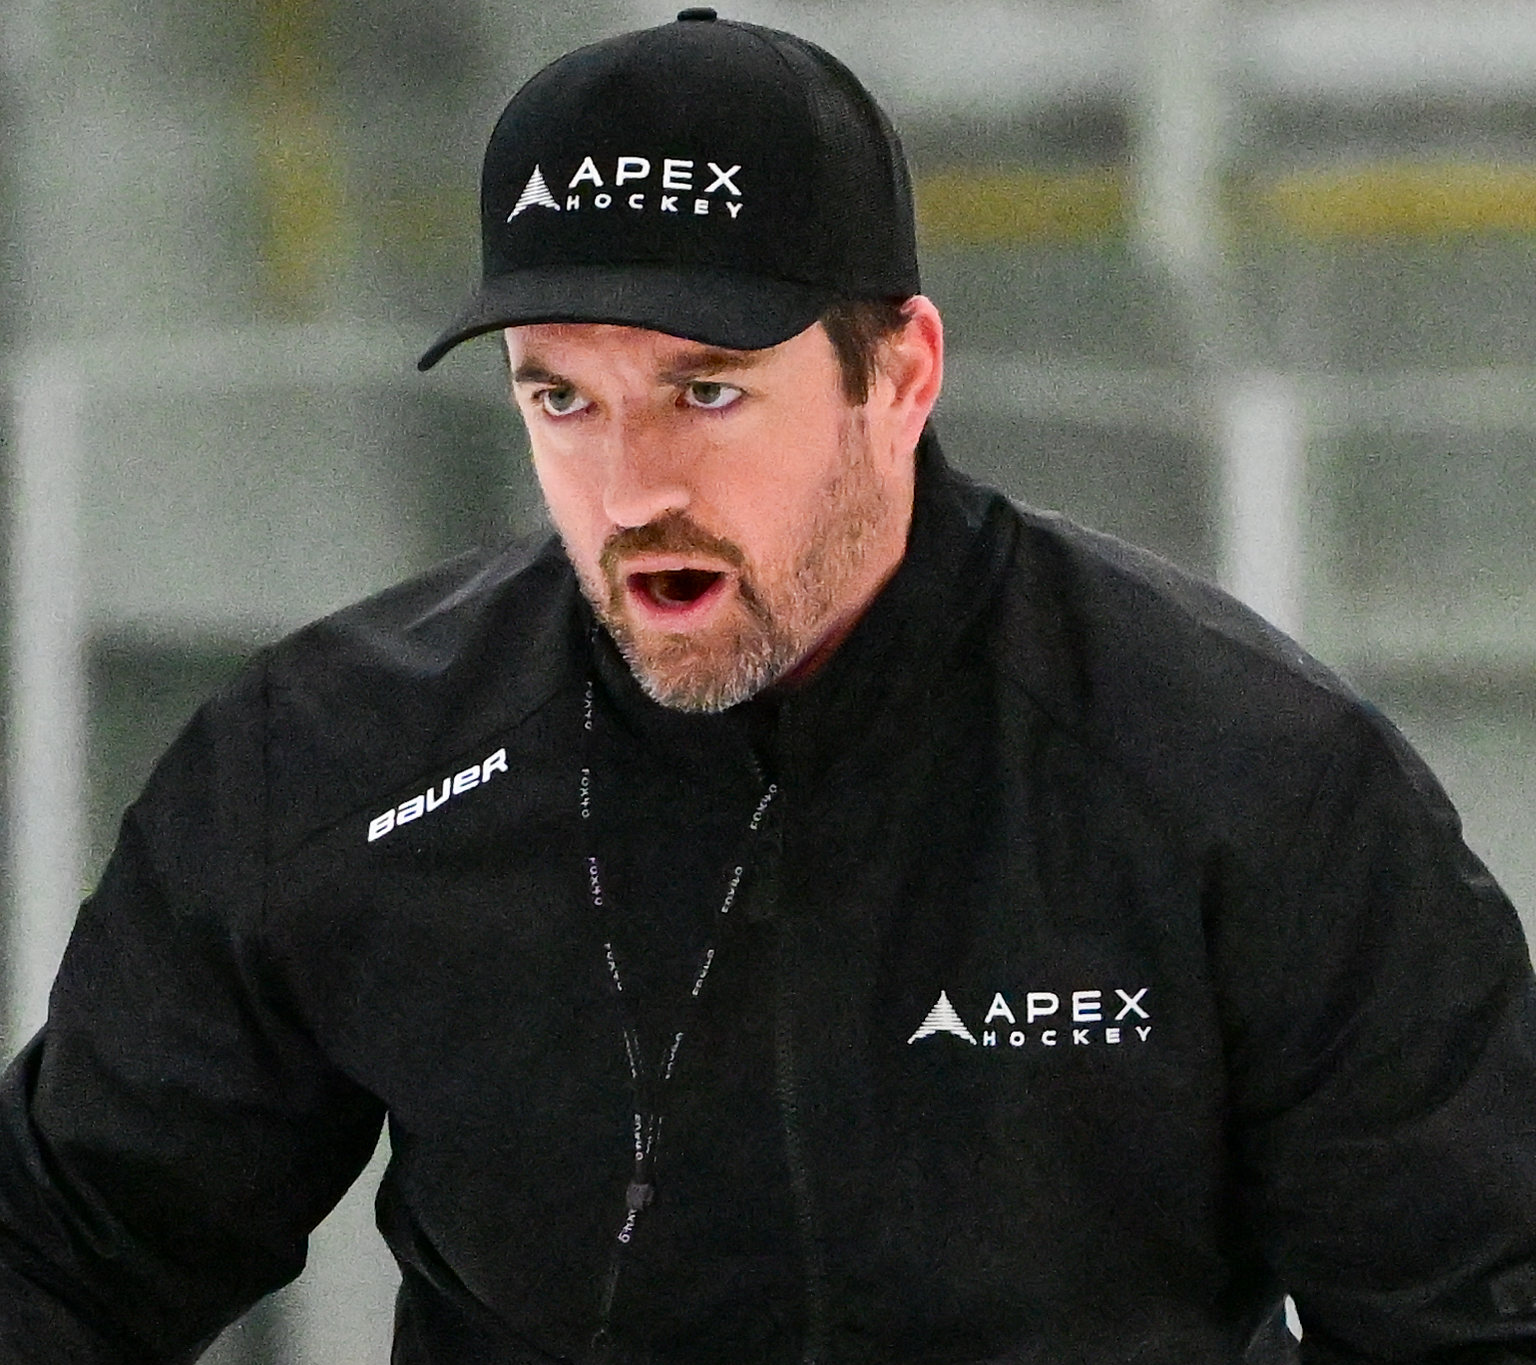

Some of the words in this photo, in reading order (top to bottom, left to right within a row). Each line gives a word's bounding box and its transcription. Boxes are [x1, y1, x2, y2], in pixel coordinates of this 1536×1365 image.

[568, 156, 743, 195] APEX
[566, 195, 744, 219] HOCKEY
[984, 988, 1151, 1024] APEX
[982, 1025, 1153, 1047] HOCKEY
